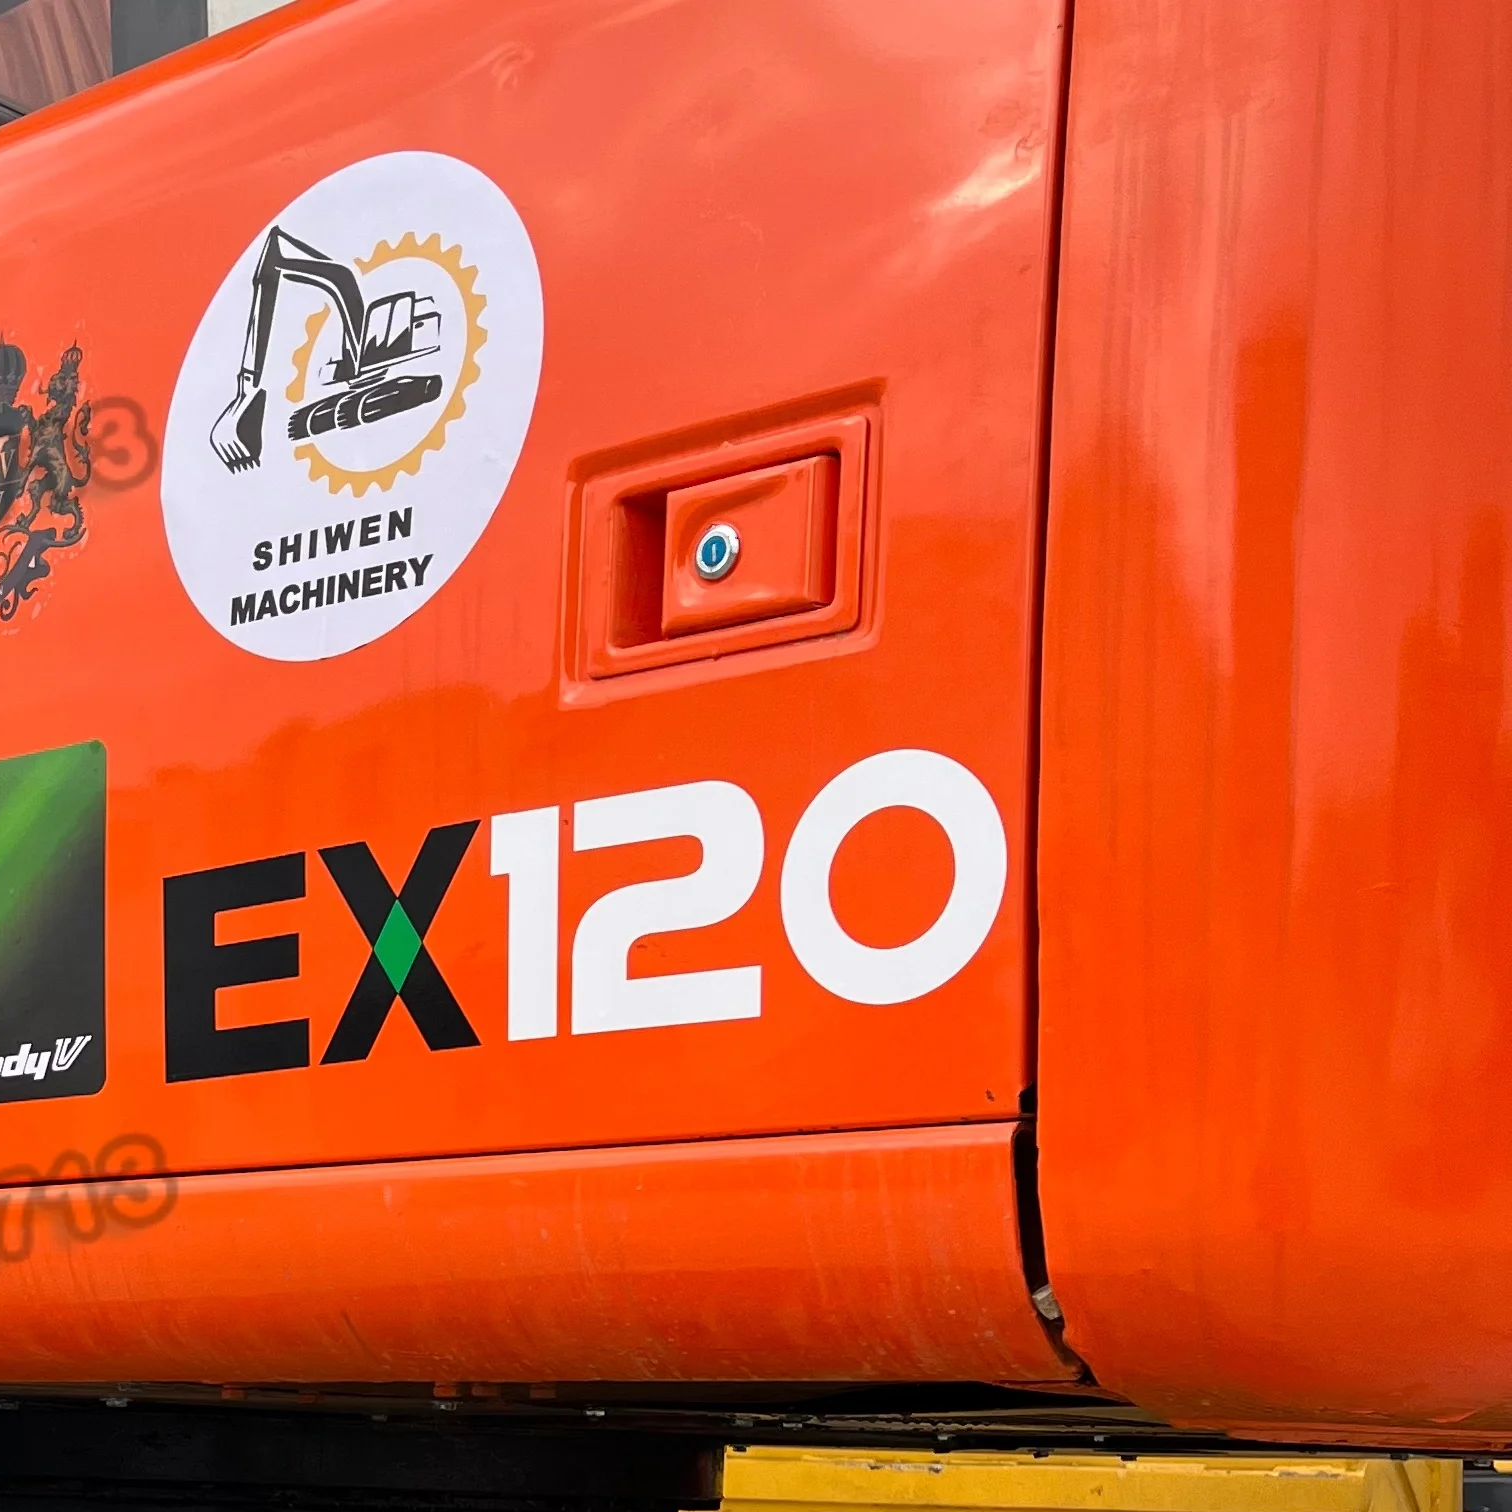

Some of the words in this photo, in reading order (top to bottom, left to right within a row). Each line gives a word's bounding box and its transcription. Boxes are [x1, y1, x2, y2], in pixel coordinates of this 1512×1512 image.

[252, 506, 413, 572] SHIWEN
[229, 553, 435, 627] MACHINERY
[162, 747, 1008, 1083] EX120
